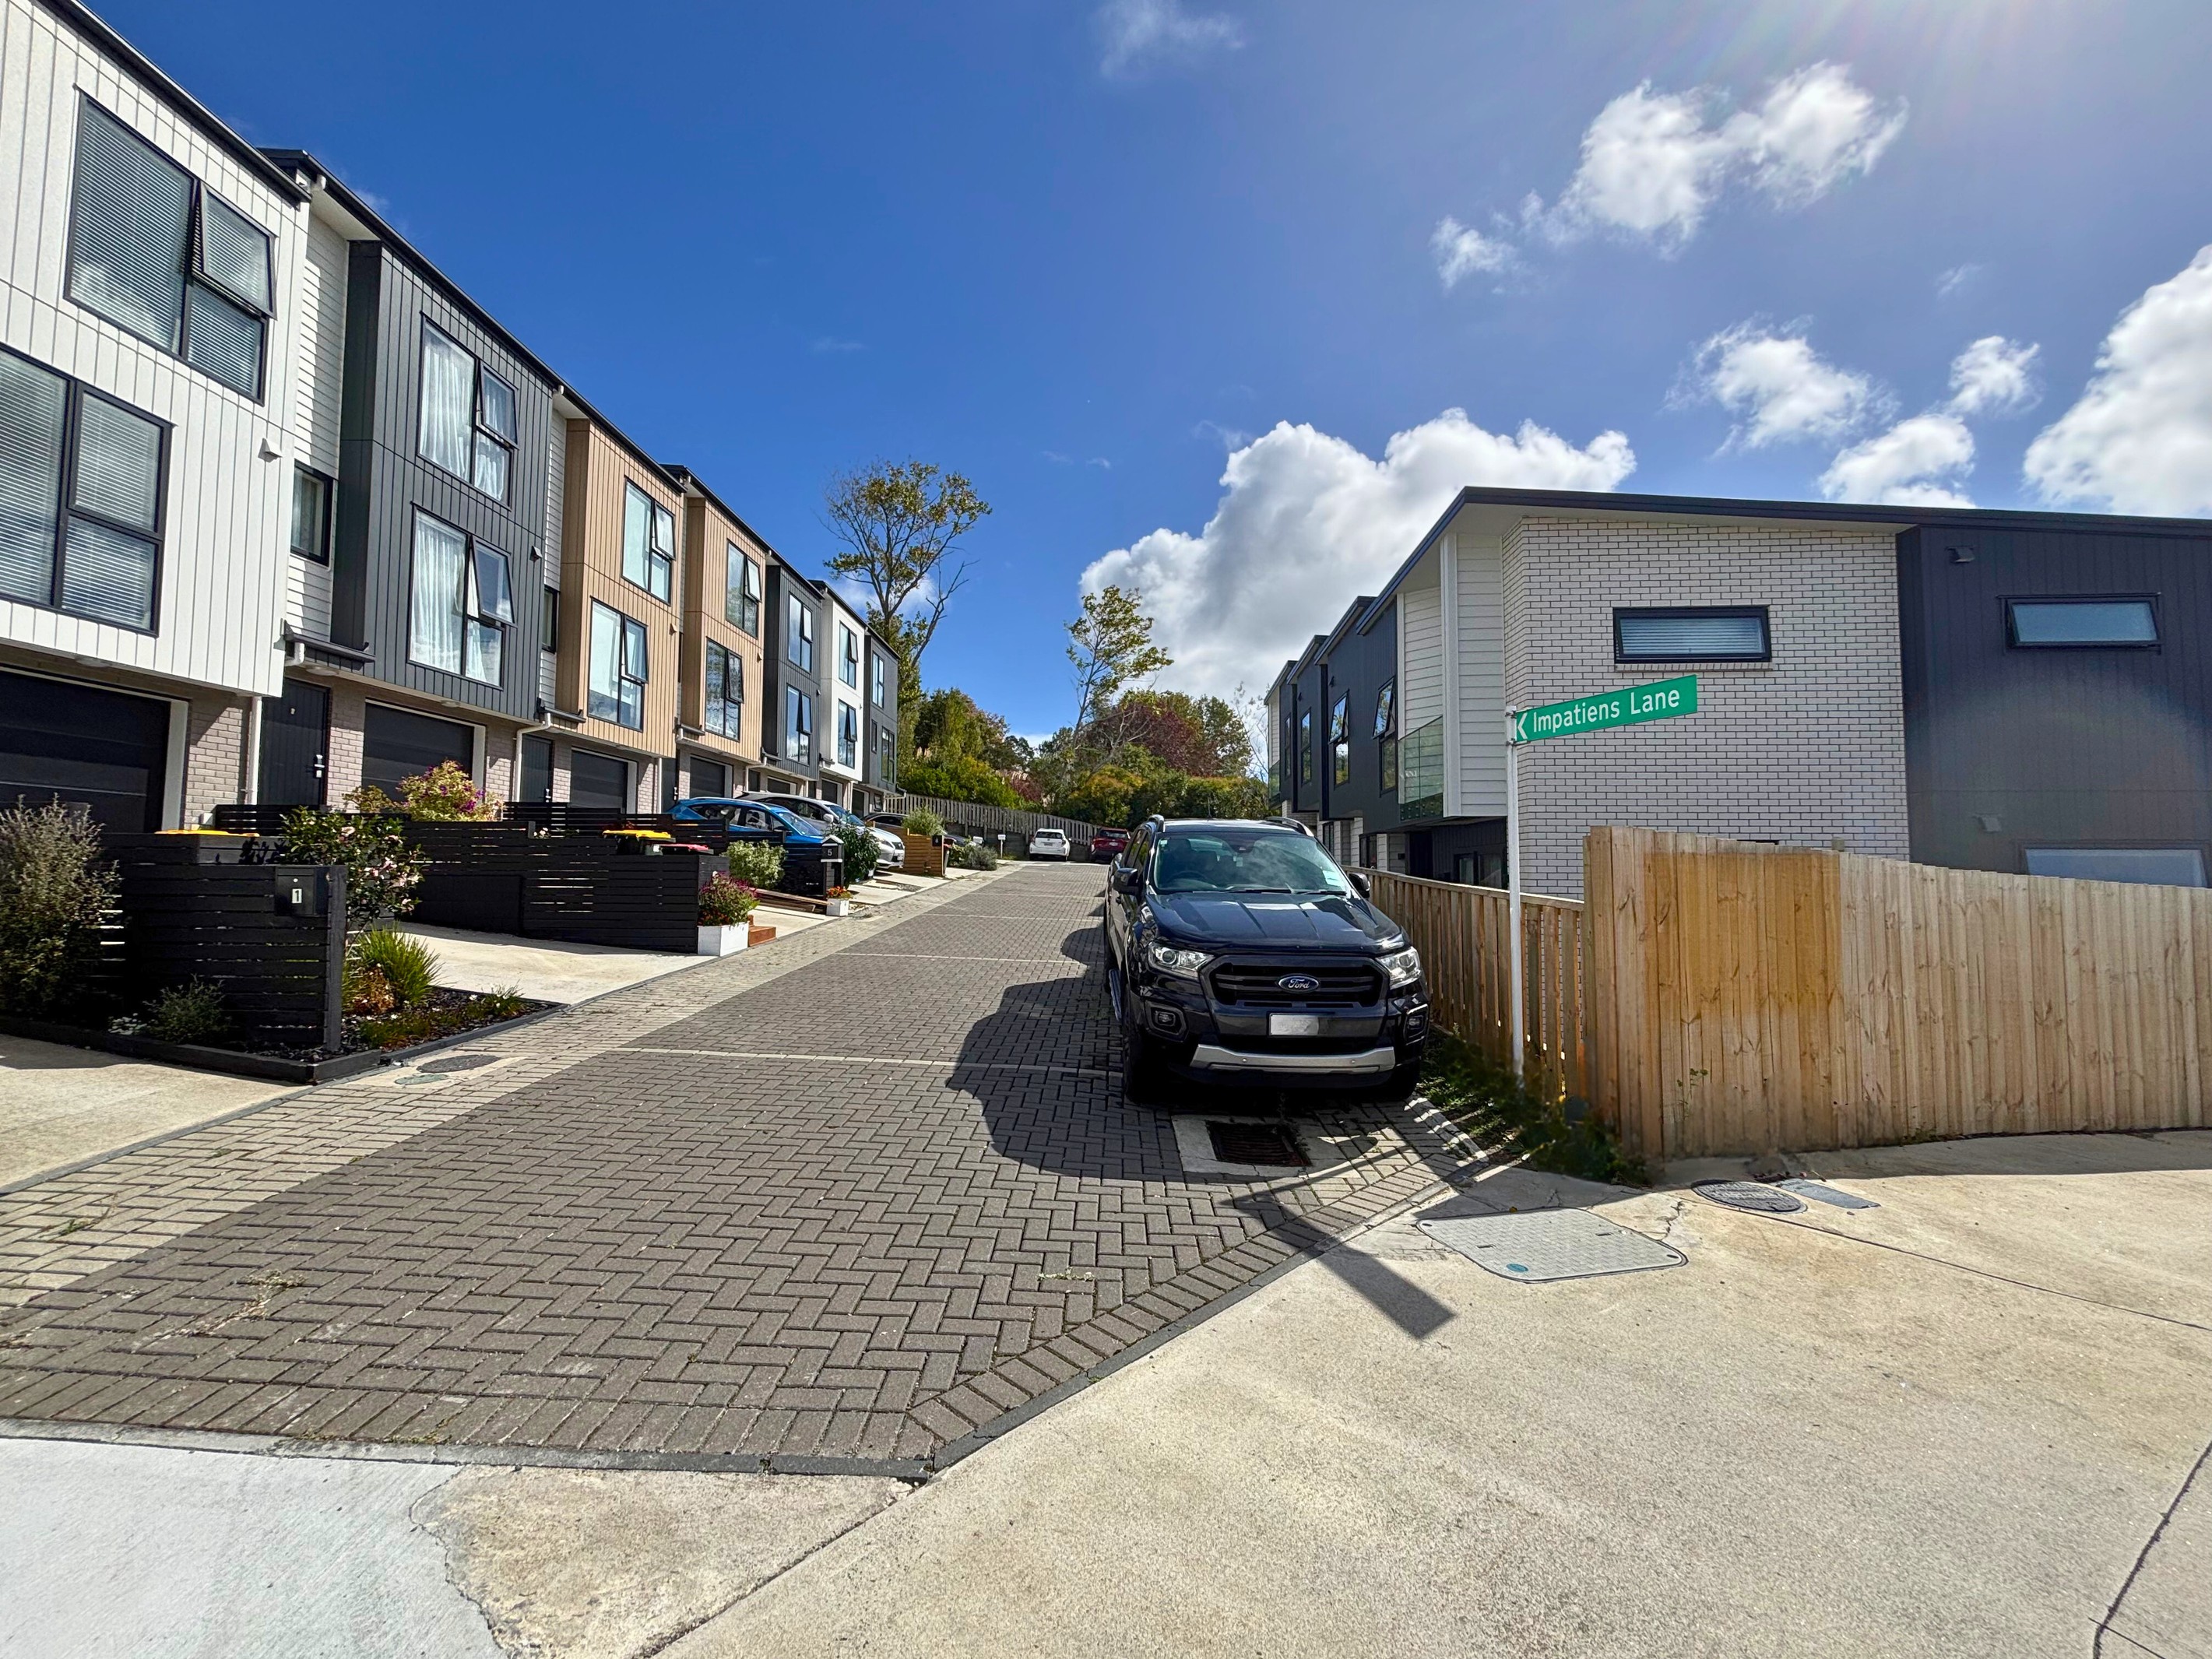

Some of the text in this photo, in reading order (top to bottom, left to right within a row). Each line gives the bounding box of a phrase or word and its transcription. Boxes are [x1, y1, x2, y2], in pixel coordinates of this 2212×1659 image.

[1533, 689, 1680, 733] Impatiens Lane
[1288, 978, 1310, 989] Ford
